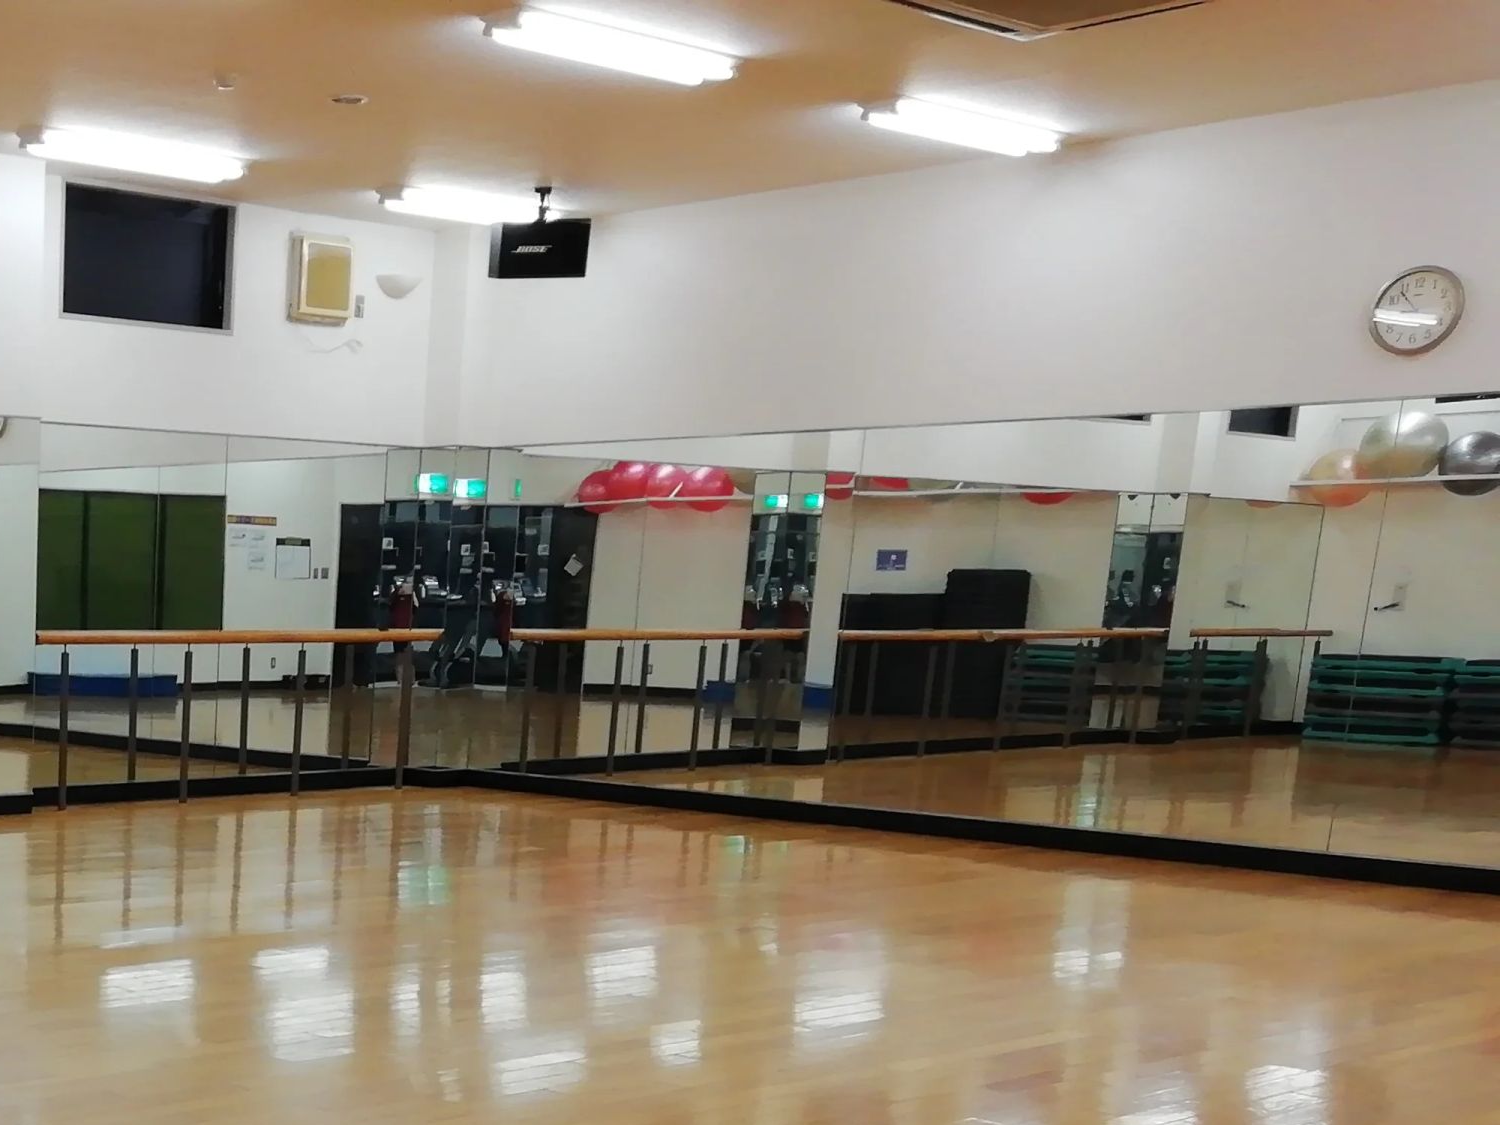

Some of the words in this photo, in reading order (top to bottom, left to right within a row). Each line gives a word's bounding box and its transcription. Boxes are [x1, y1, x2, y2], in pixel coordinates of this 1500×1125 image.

[510, 245, 553, 254] BOSE
[1414, 277, 1426, 288] 12
[1440, 288, 1448, 298] 2
[1408, 333, 1417, 344] 6
